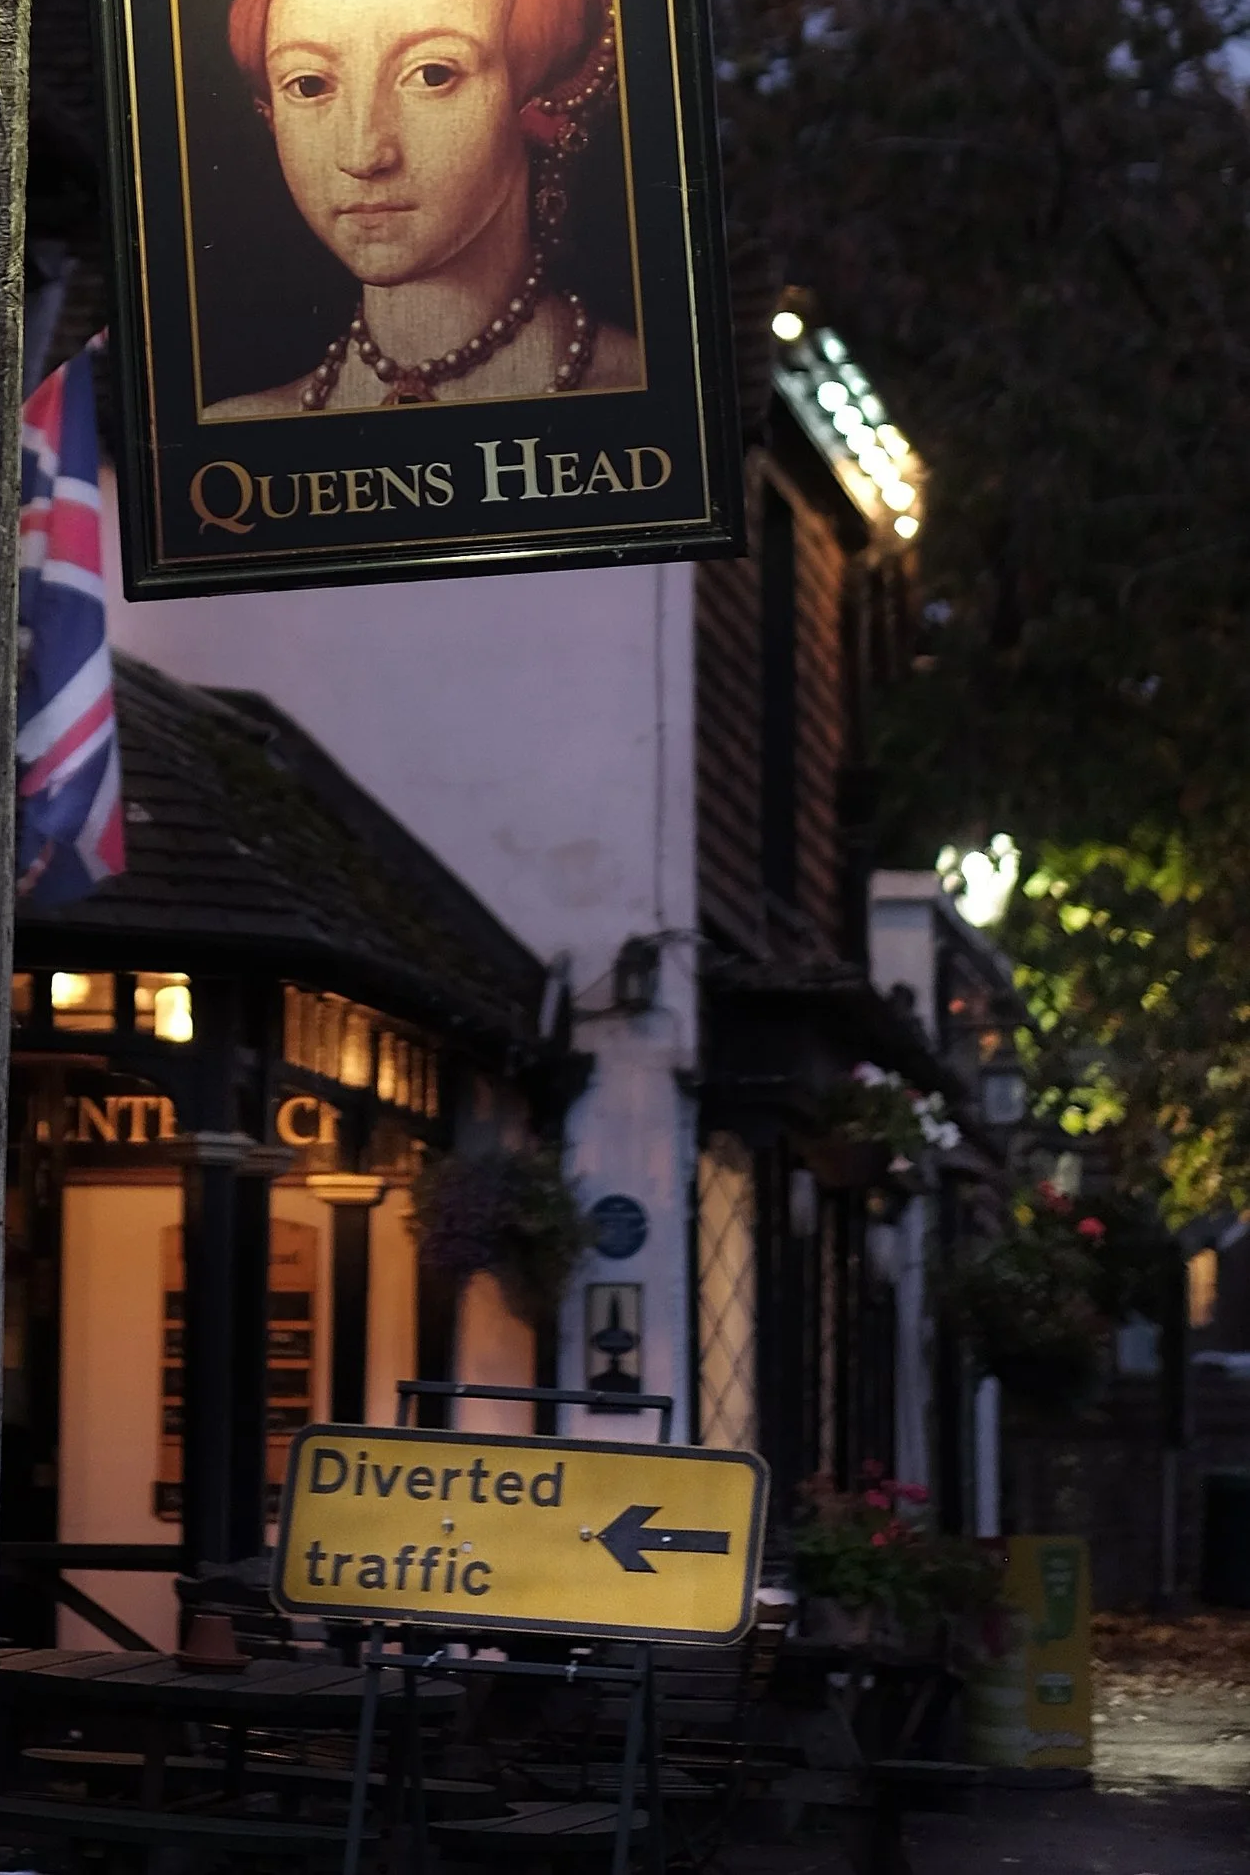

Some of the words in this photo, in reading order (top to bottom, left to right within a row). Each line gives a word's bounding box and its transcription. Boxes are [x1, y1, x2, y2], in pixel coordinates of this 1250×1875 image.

[190, 460, 454, 535] QUEENS
[475, 437, 673, 504] HEAD
[309, 1447, 566, 1508] Diverted
[305, 1540, 493, 1596] traffic
